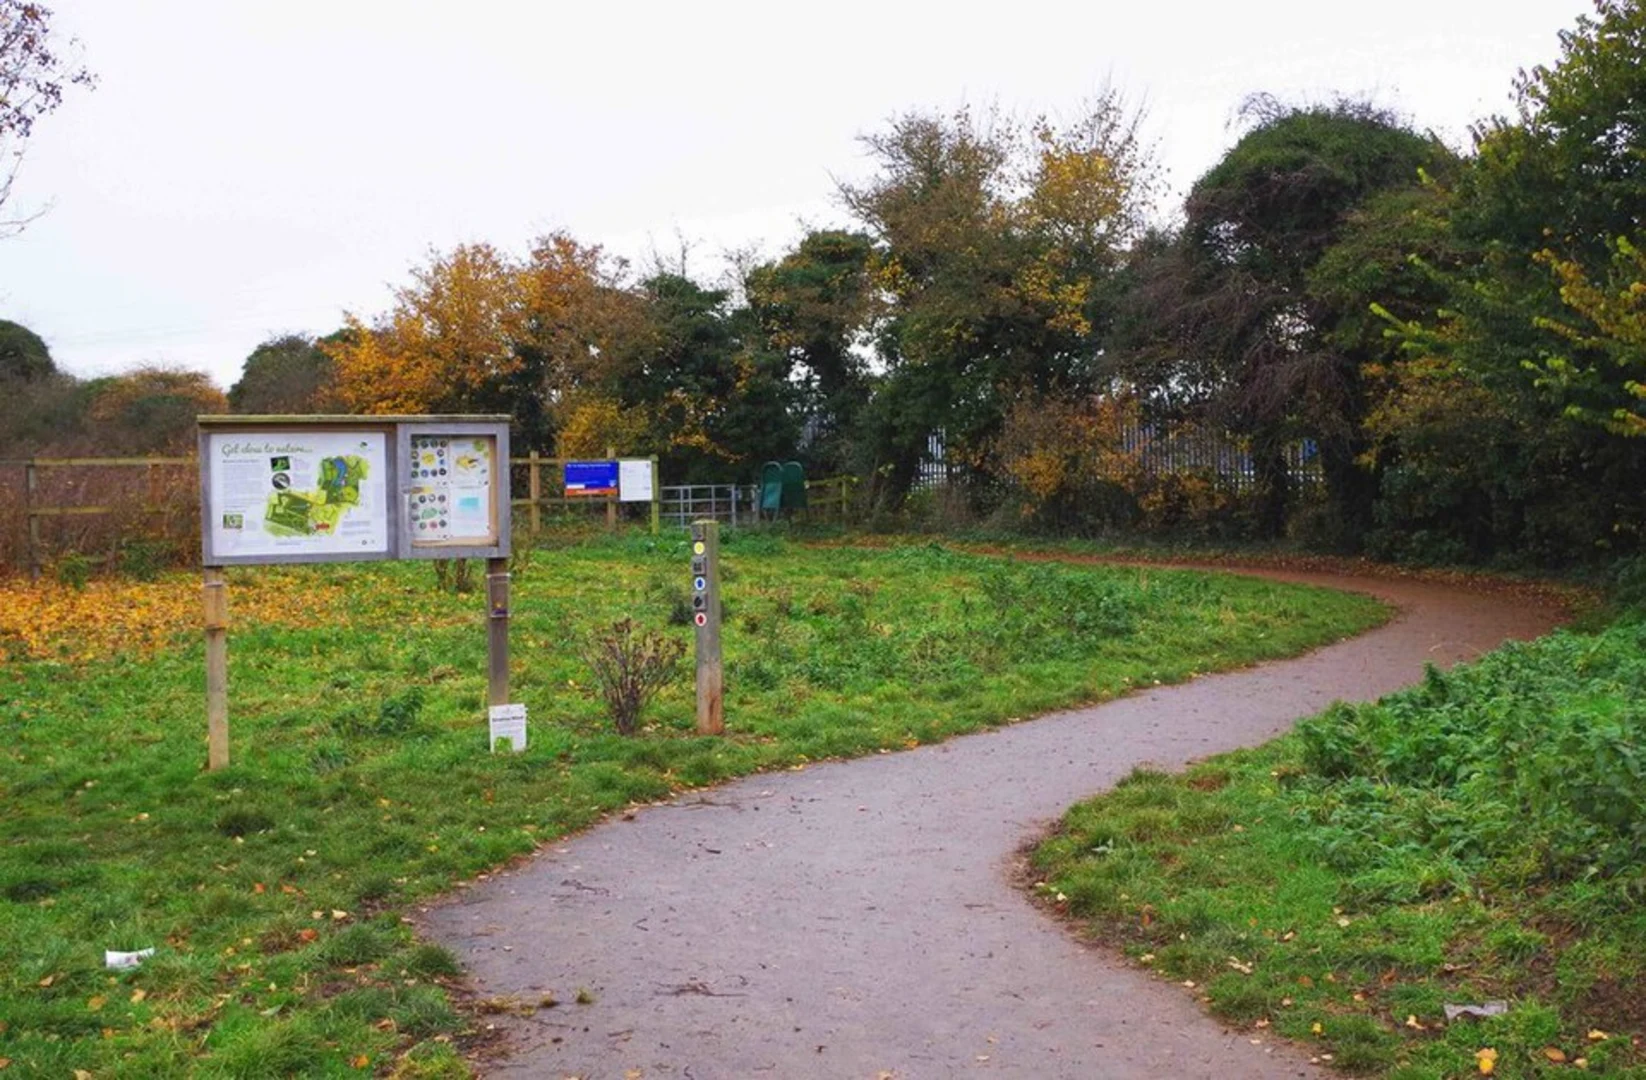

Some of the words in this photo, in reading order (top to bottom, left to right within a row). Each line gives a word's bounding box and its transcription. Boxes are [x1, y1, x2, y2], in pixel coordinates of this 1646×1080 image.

[221, 443, 240, 457] Get
[242, 442, 263, 454] close
[264, 442, 275, 453] to
